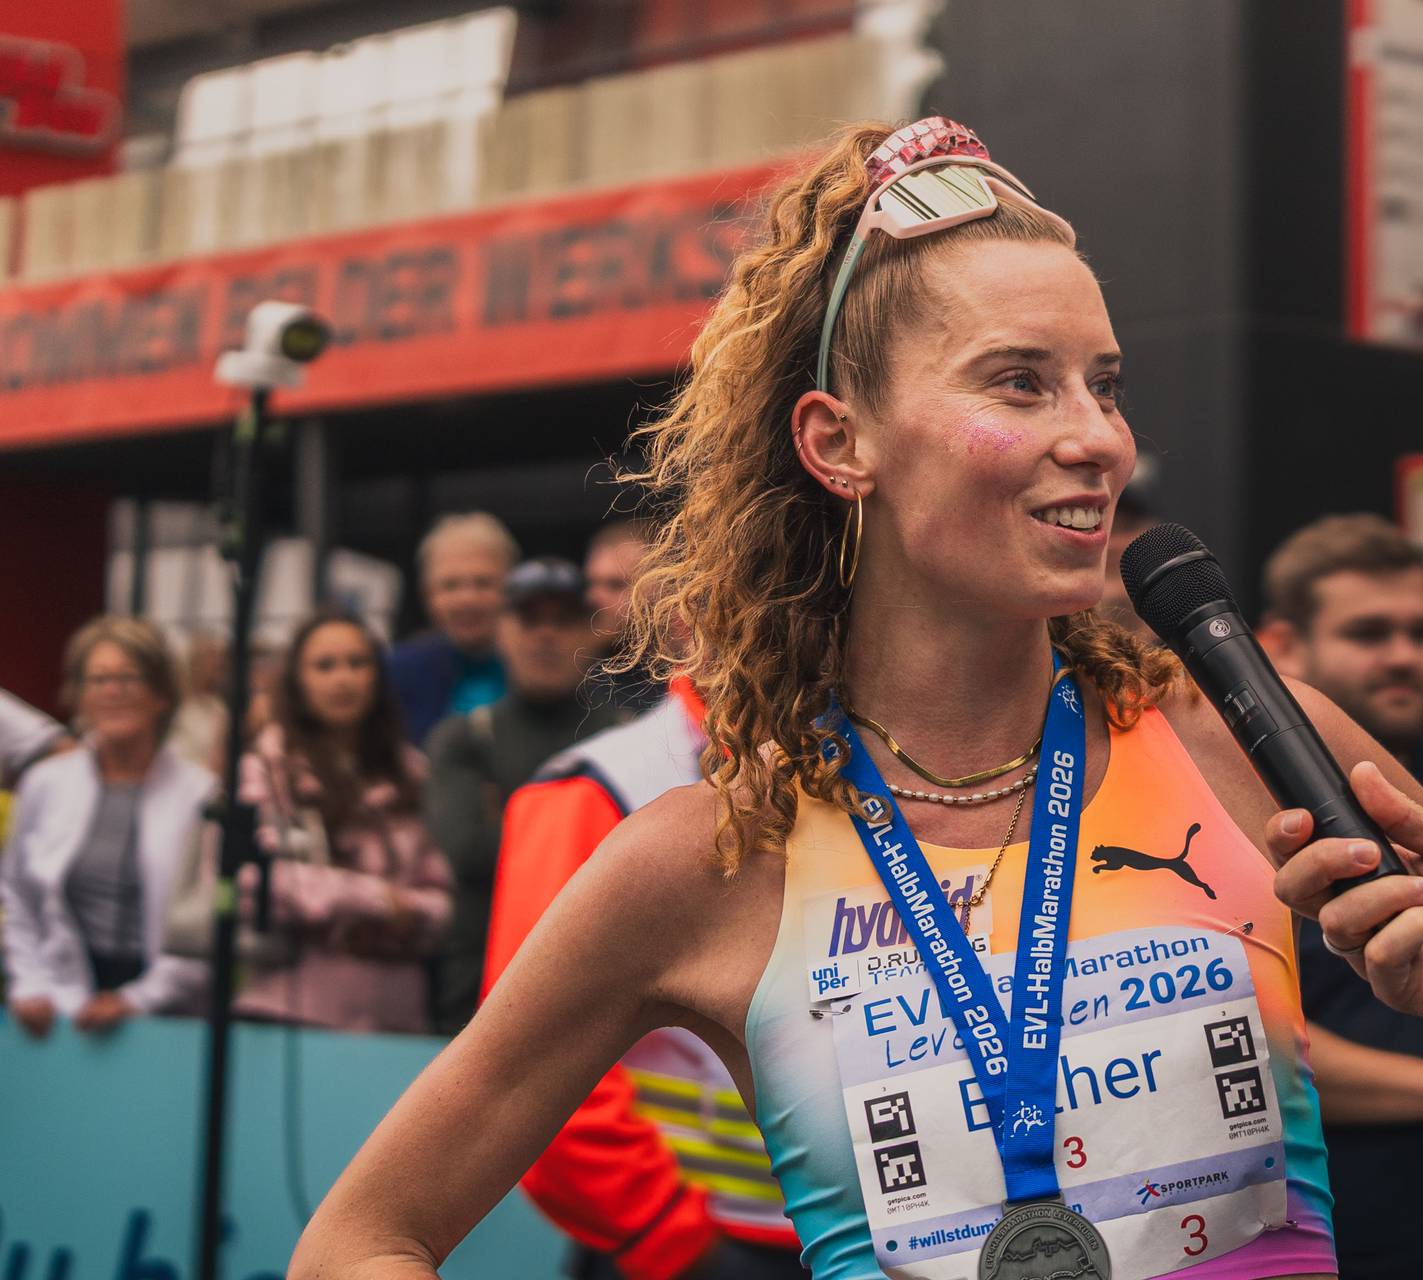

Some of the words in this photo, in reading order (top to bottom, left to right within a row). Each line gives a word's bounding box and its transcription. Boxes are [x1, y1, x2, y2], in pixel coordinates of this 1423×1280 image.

[1022, 824, 1068, 1050] EVL-HalbMarathon
[1048, 750, 1075, 818] 2026
[861, 797, 974, 1003] EVL-HalbMarathon
[963, 1005, 1009, 1078] 2026
[812, 963, 838, 982] uni
[818, 976, 850, 995] per
[1119, 956, 1234, 1012] 2026
[1229, 1117, 1267, 1132] getpica.com
[1063, 1136, 1088, 1169] 3
[1160, 1170, 1230, 1193] SPORTPARK
[1180, 1214, 1209, 1257] 3
